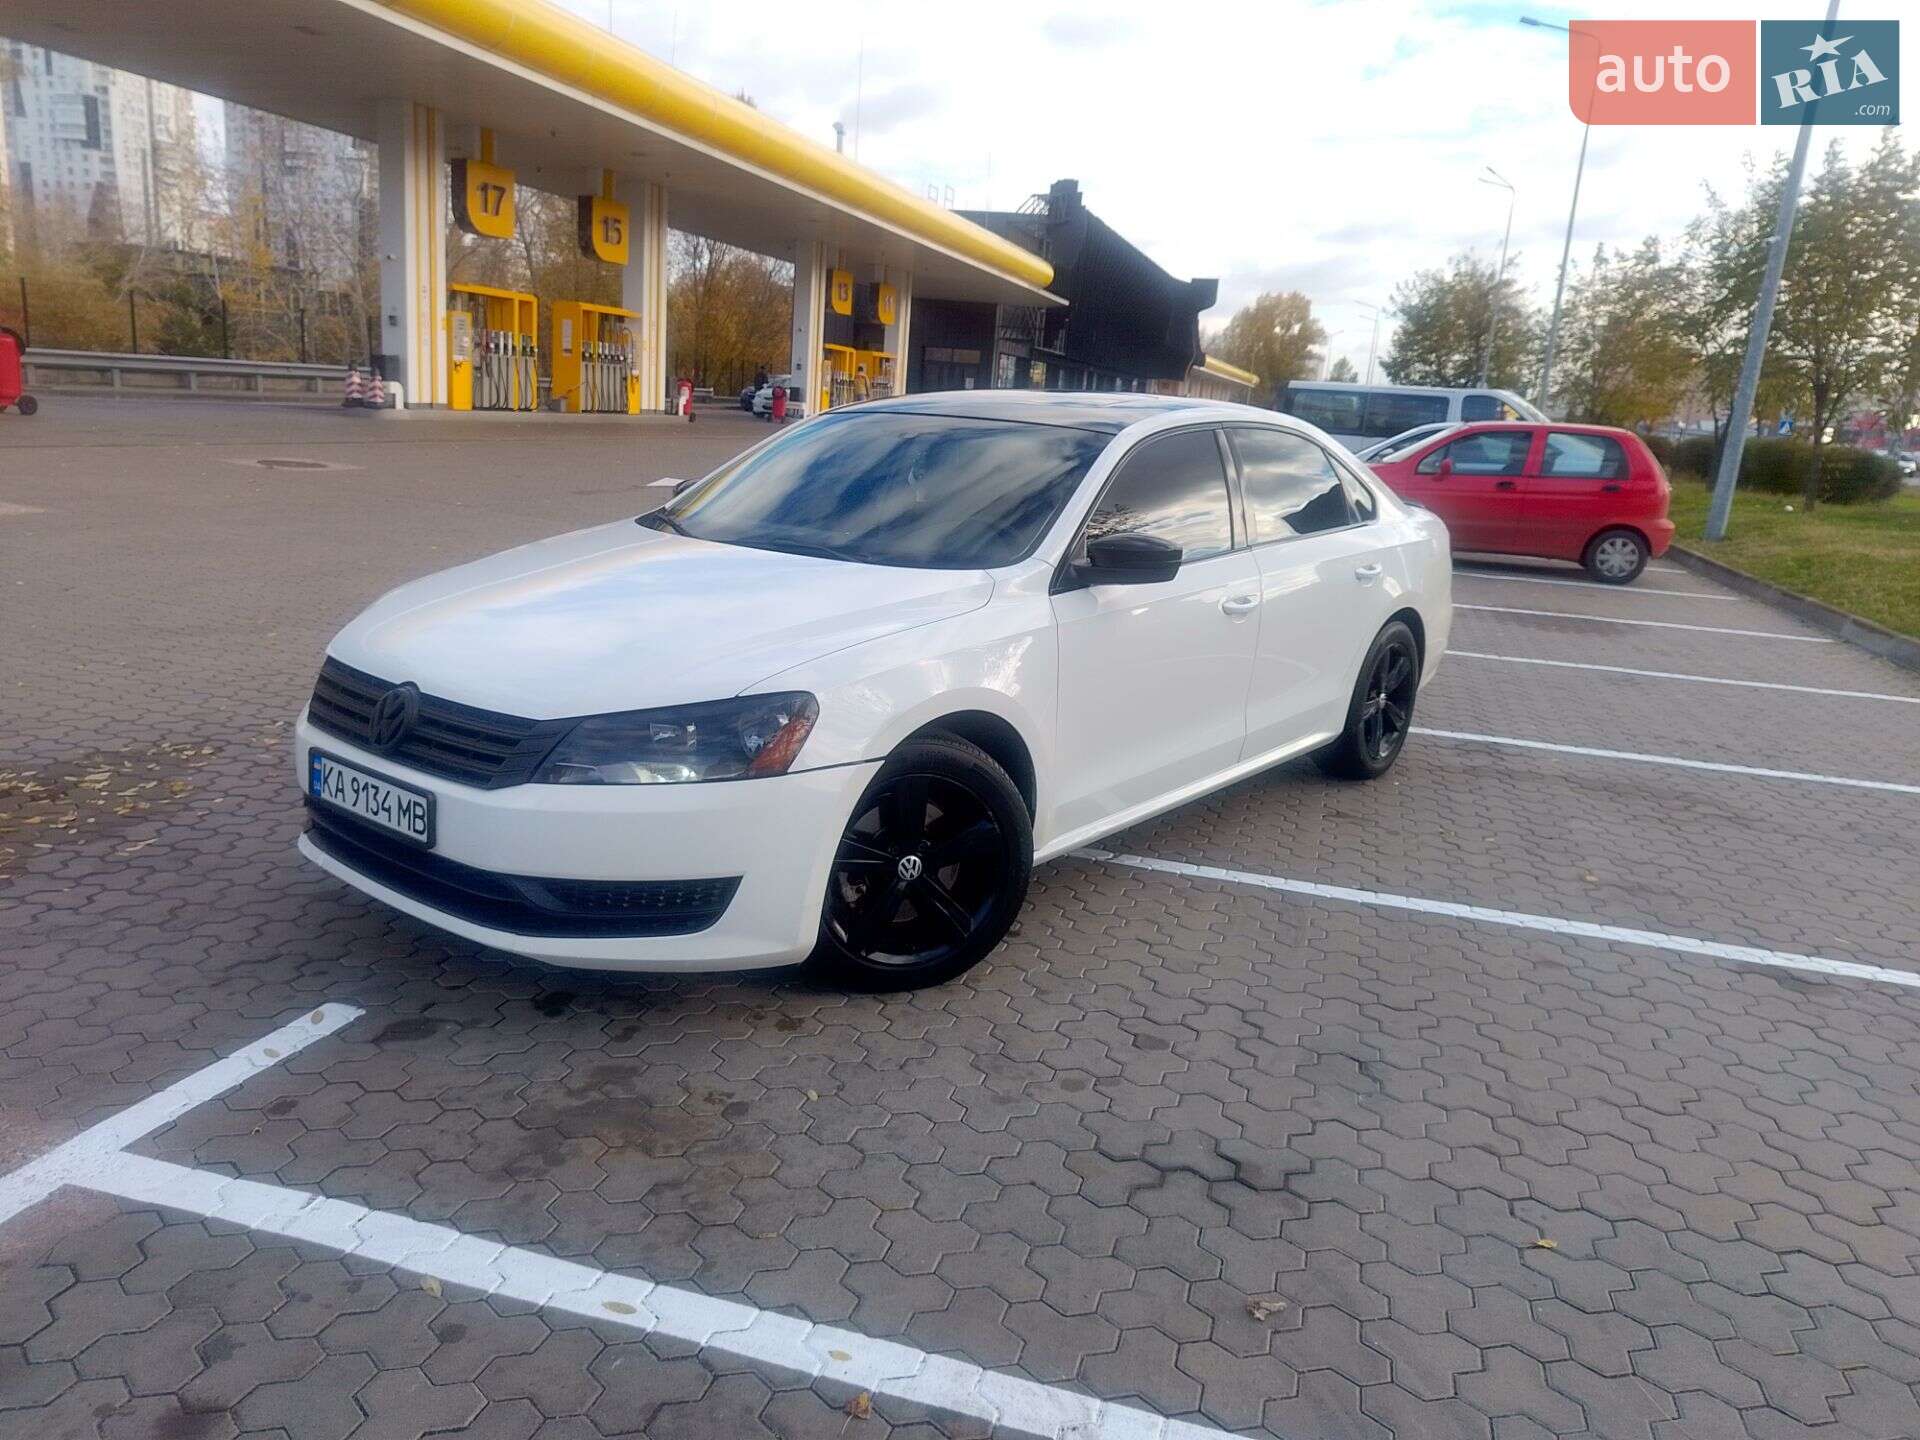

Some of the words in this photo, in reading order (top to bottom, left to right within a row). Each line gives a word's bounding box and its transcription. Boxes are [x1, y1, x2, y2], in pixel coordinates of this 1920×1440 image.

[478, 182, 506, 216] 17
[602, 216, 622, 246] 15
[322, 763, 345, 803] KA
[351, 777, 391, 823] 9134
[398, 795, 426, 835] MB
